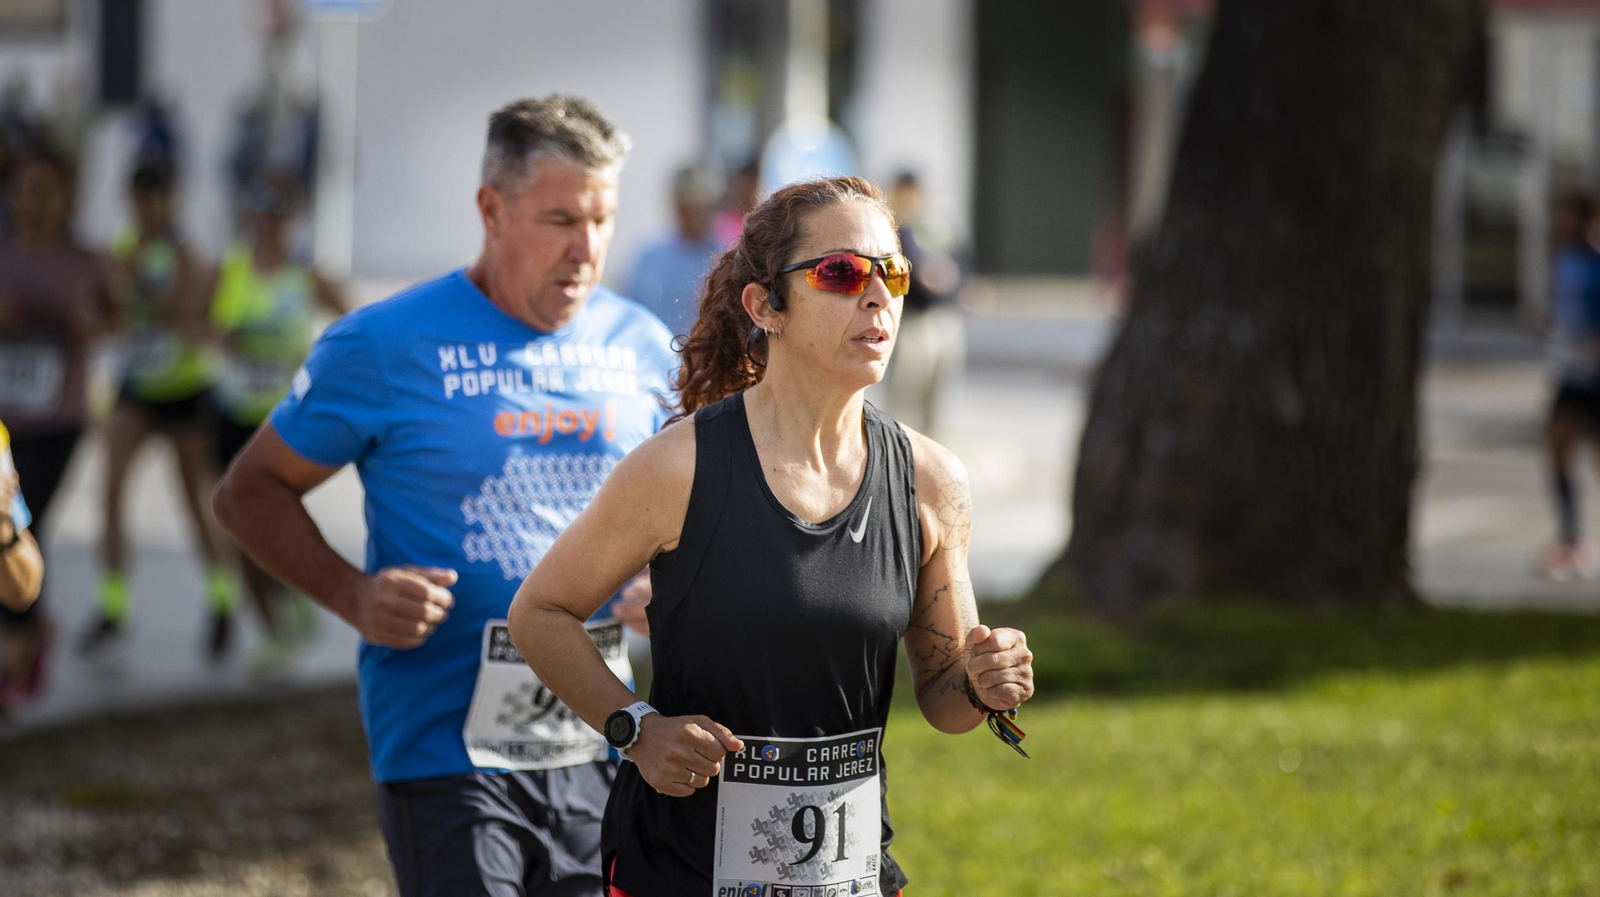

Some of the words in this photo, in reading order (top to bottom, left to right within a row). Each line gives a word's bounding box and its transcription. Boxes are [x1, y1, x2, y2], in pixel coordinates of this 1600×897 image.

[444, 368, 565, 399] POPULAR
[494, 402, 616, 444] enjoy!
[806, 739, 874, 763] CARREA
[733, 763, 830, 782] POPULAR
[835, 757, 873, 779] JEREZ
[789, 801, 850, 866] 91
